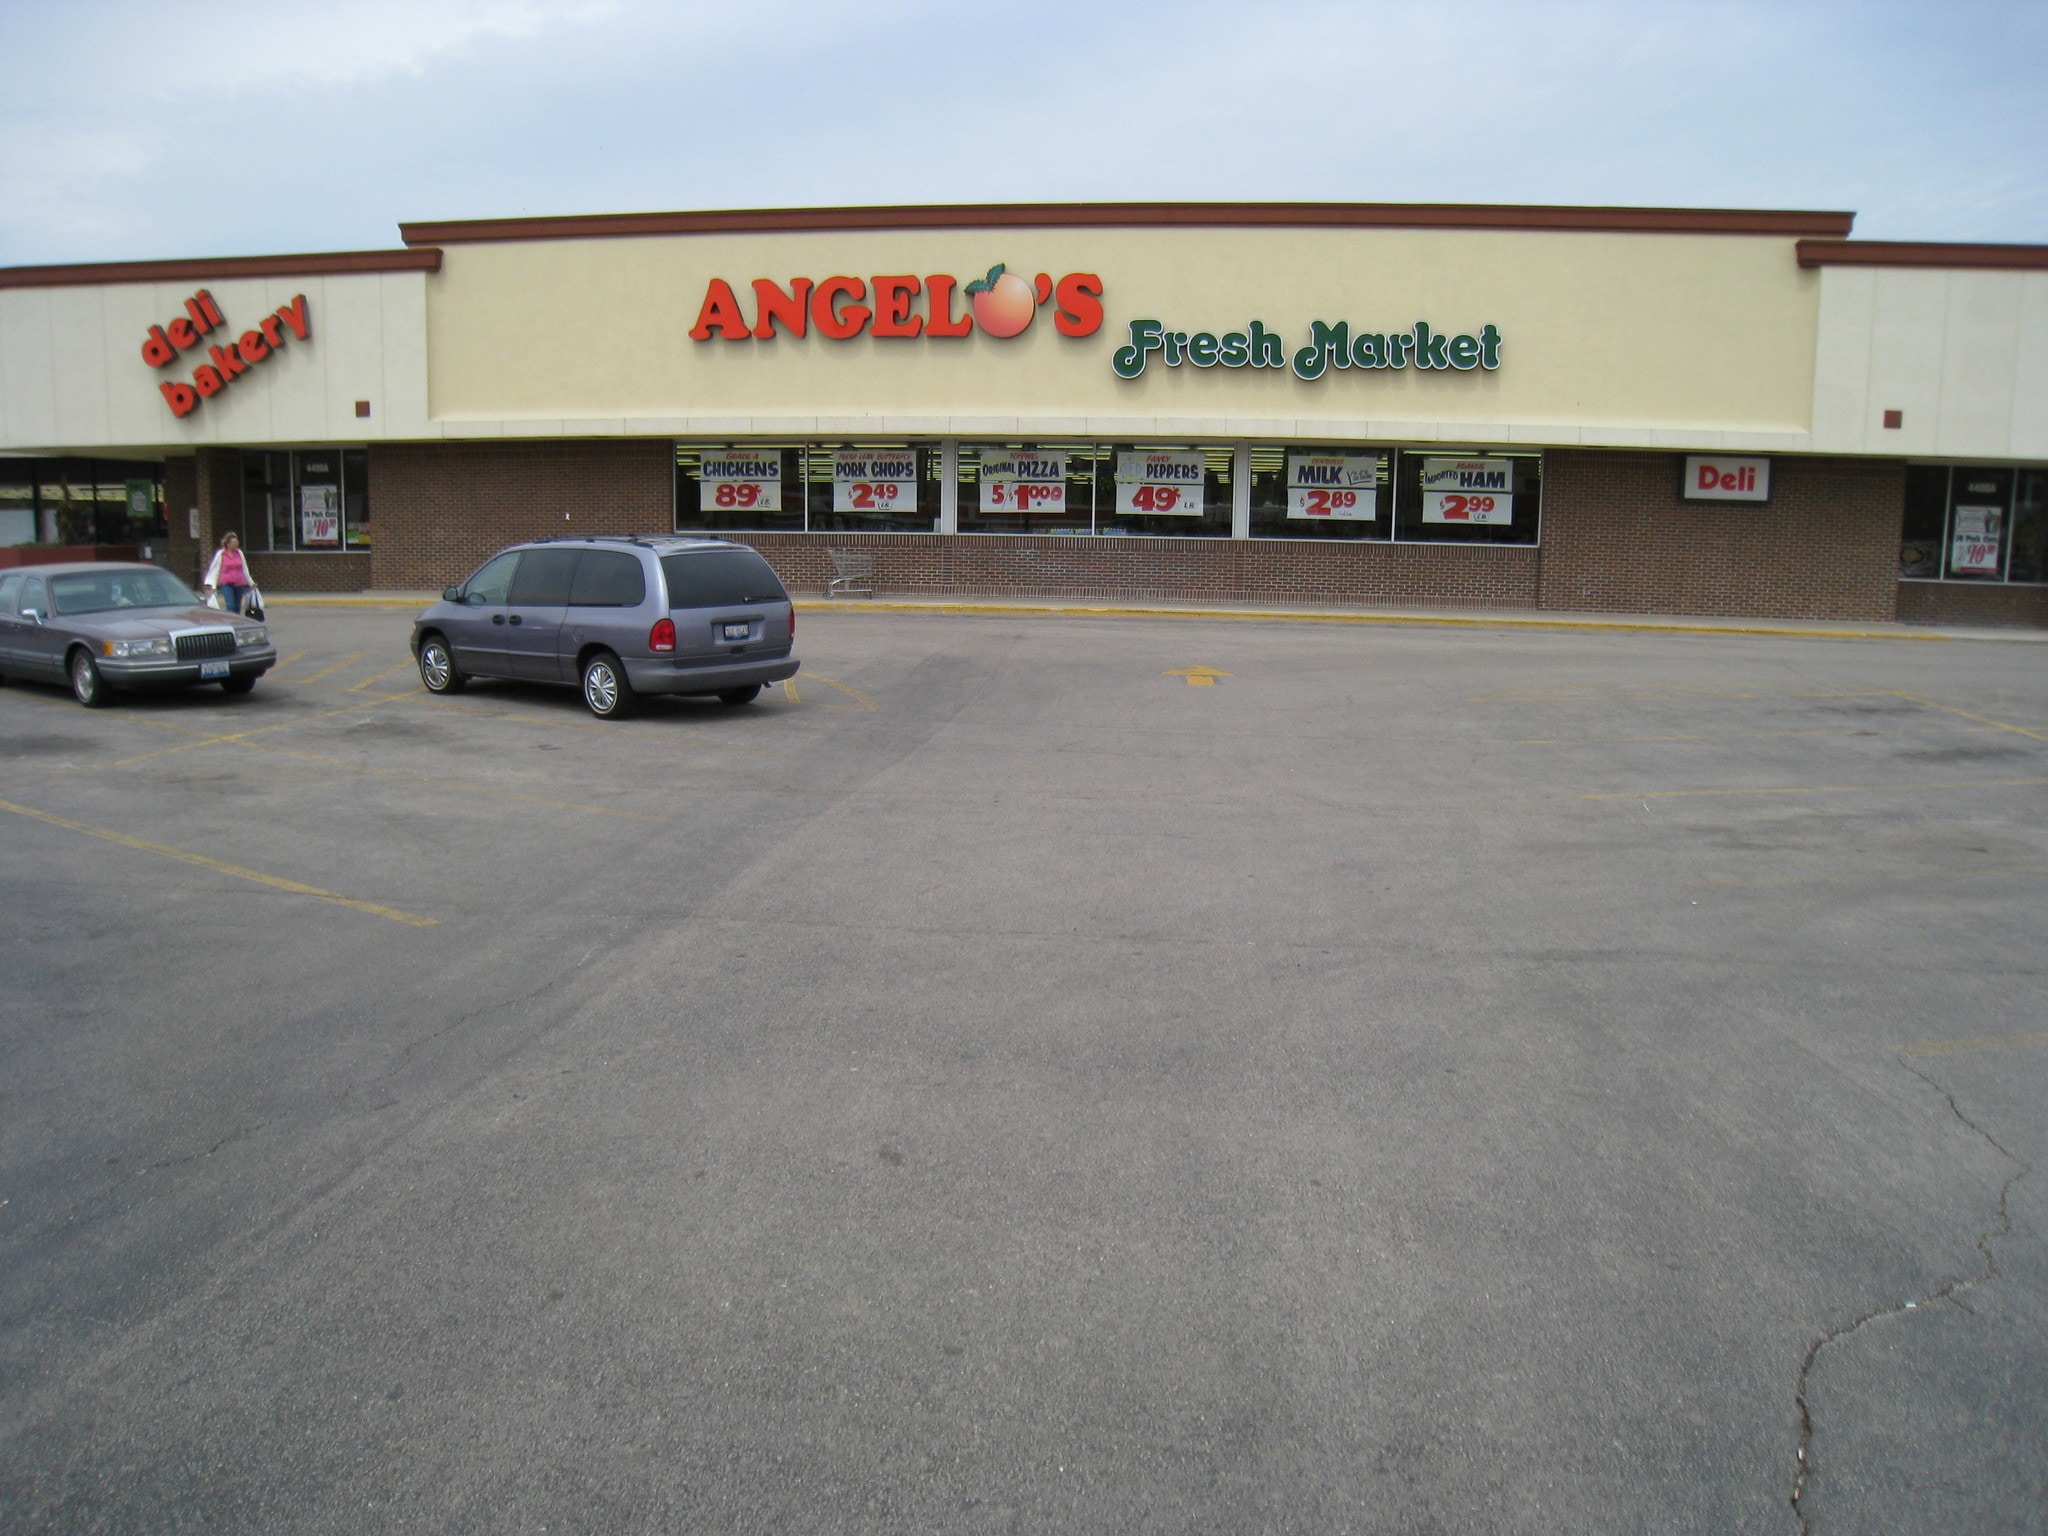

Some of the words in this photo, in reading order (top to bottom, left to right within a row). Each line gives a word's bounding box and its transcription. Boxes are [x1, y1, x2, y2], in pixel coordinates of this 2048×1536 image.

[141, 288, 226, 369] deli
[159, 293, 311, 418] bakery
[1111, 318, 1286, 380] Fresh
[1292, 319, 1502, 382] Market
[703, 460, 779, 477] CHICKENS
[835, 461, 867, 478] PORK
[871, 461, 914, 478] CHOPS
[982, 462, 1017, 476] ORIGINAL
[1018, 461, 1060, 478] PIZZA
[1146, 463, 1199, 480] PEPPERS
[1297, 465, 1343, 485] MILK
[1424, 469, 1459, 484] IMPORTED
[1459, 471, 1506, 488] HAM
[1698, 465, 1756, 492] Deli
